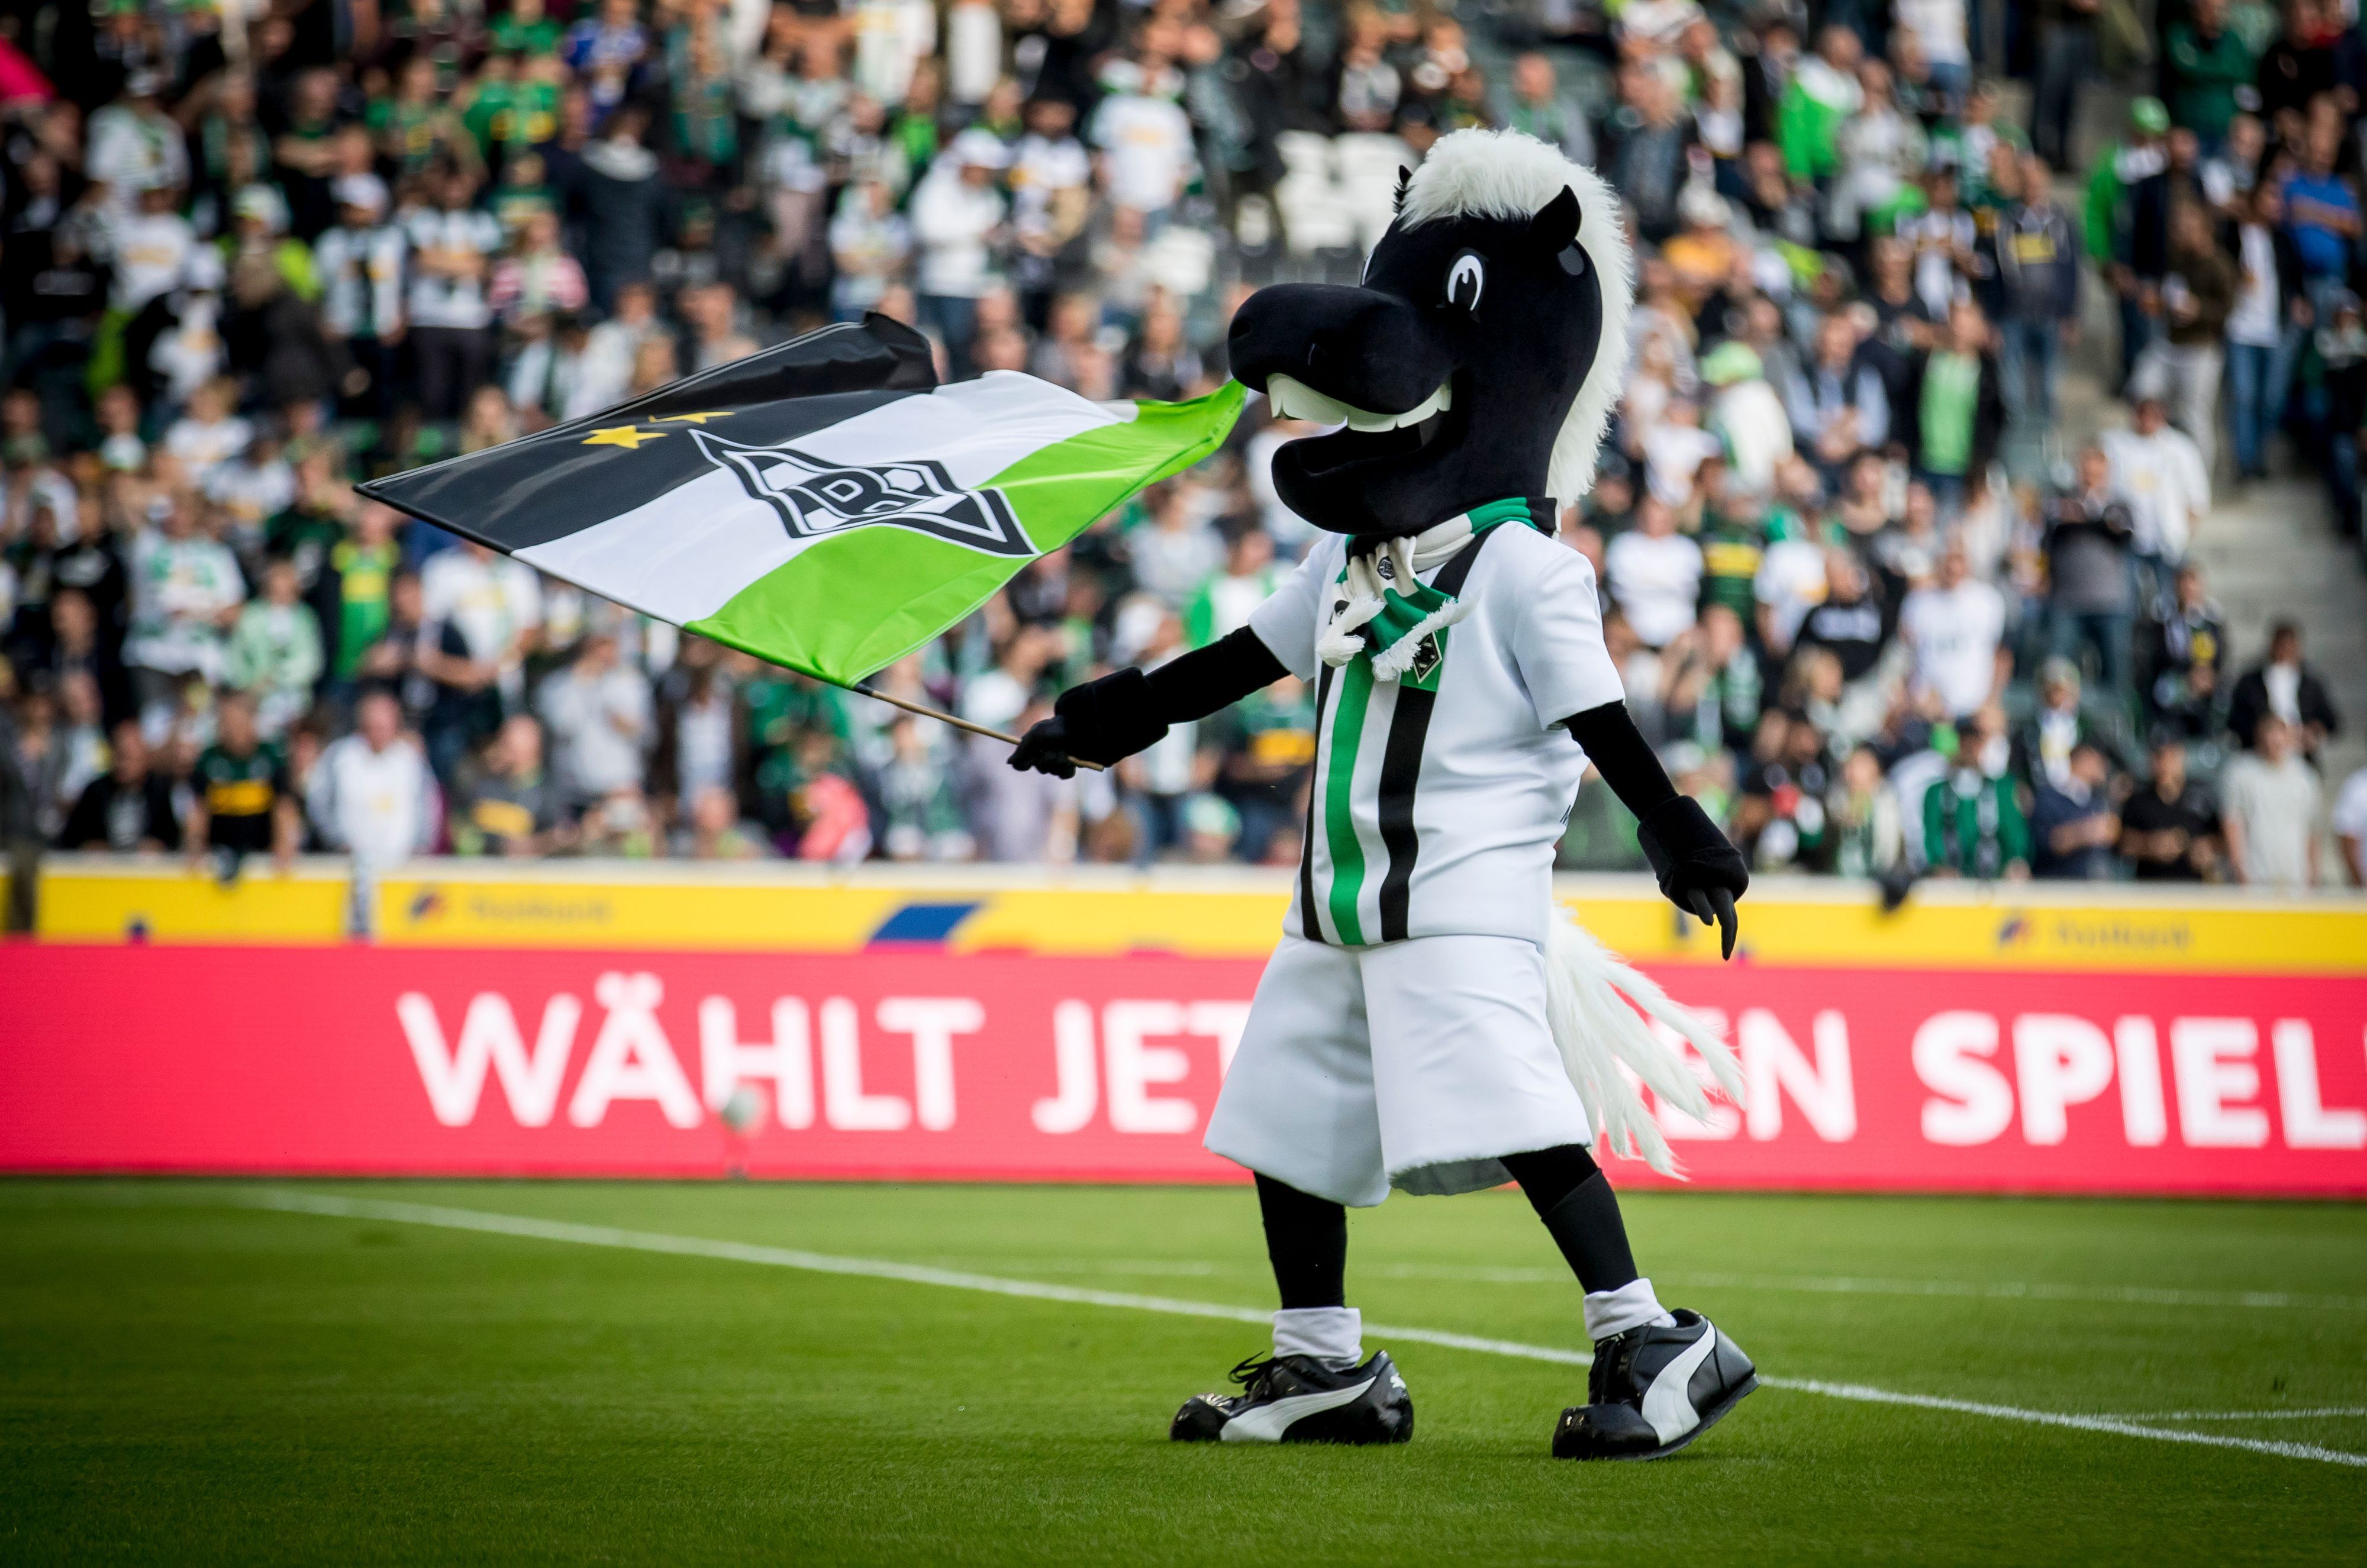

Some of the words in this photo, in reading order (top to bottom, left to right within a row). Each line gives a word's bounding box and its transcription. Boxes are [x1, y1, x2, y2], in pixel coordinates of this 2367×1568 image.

[396, 971, 986, 1131] WÄHLT
[1597, 1006, 1858, 1142] EN
[1911, 1009, 2367, 1149] SPIEL
